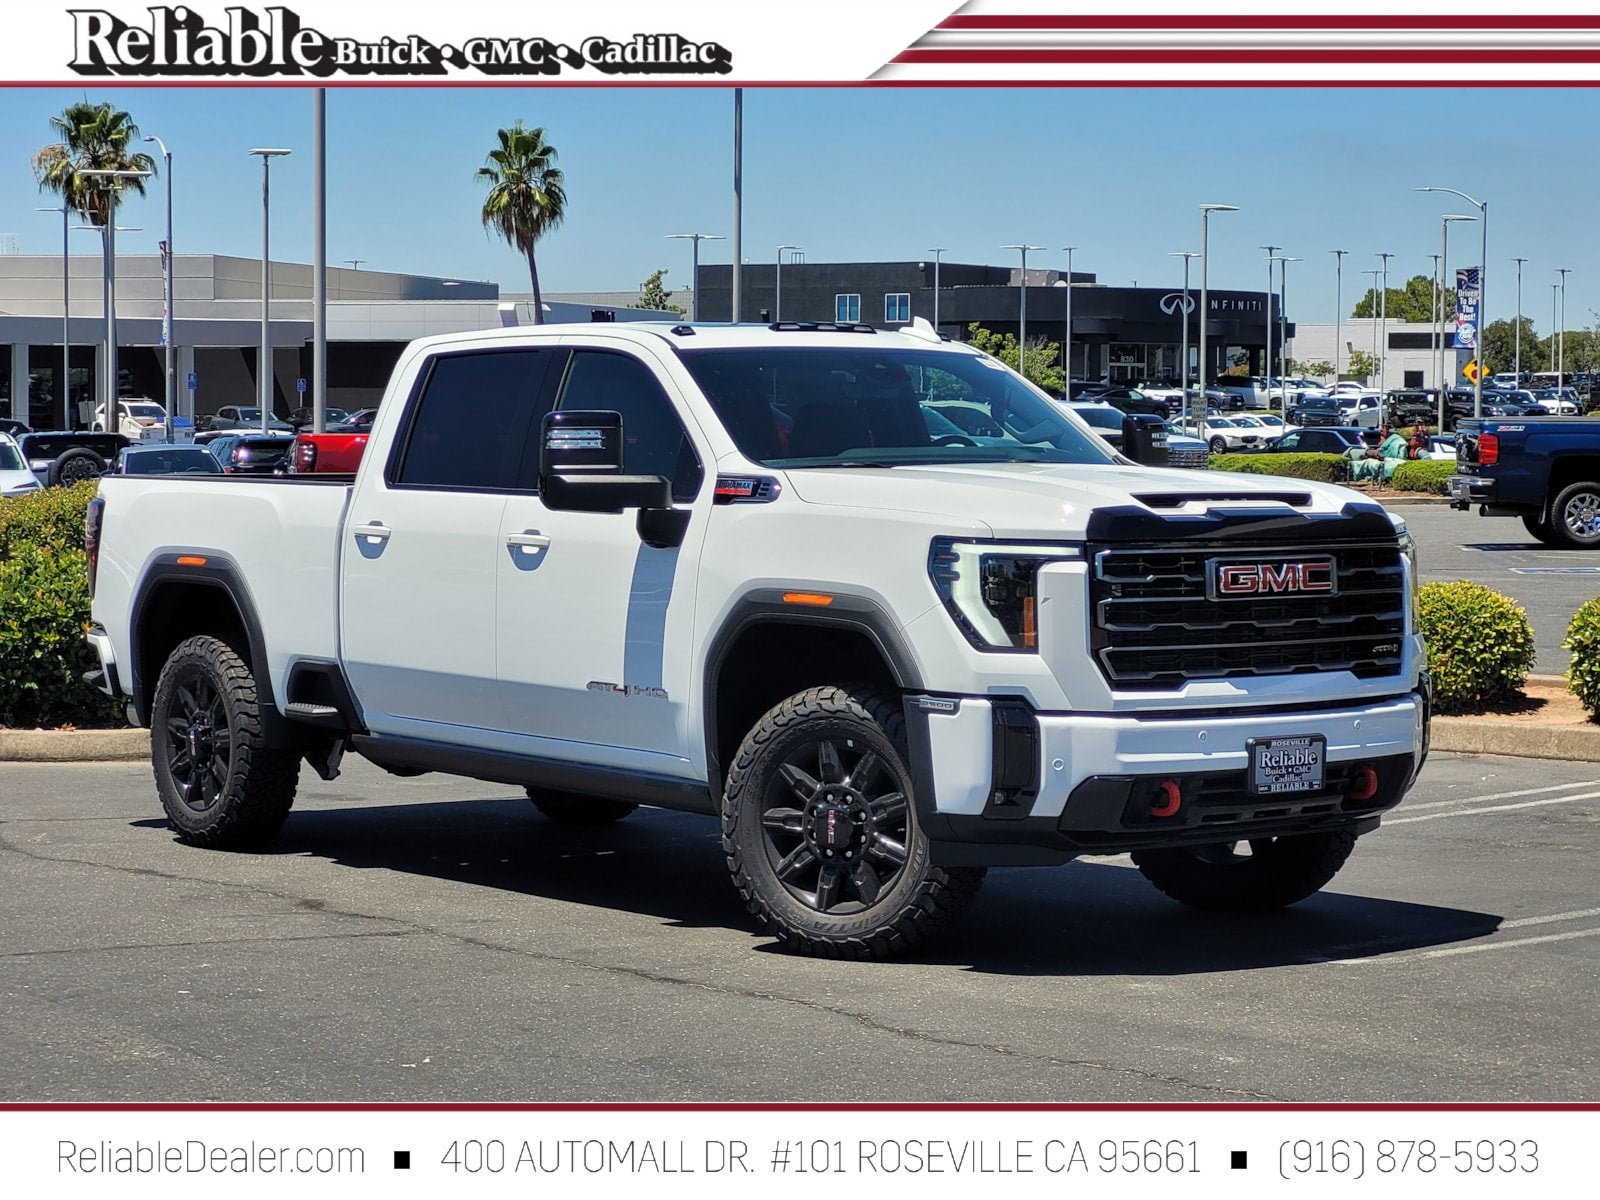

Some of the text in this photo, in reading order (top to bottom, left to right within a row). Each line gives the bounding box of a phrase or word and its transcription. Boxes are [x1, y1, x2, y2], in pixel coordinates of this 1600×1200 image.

[1206, 300, 1262, 311] NFINITI
[1468, 297, 1477, 305] Be
[1462, 305, 1474, 313] The
[1459, 312, 1476, 321] Best!
[1220, 563, 1333, 593] GMC
[920, 699, 954, 710] 2500
[1271, 738, 1310, 748] ROSEVILLE
[1260, 748, 1317, 768] Reliable
[1265, 765, 1311, 776] Buick GMC
[1272, 773, 1303, 783] Cadillac
[1271, 782, 1310, 792] RELIABLE
